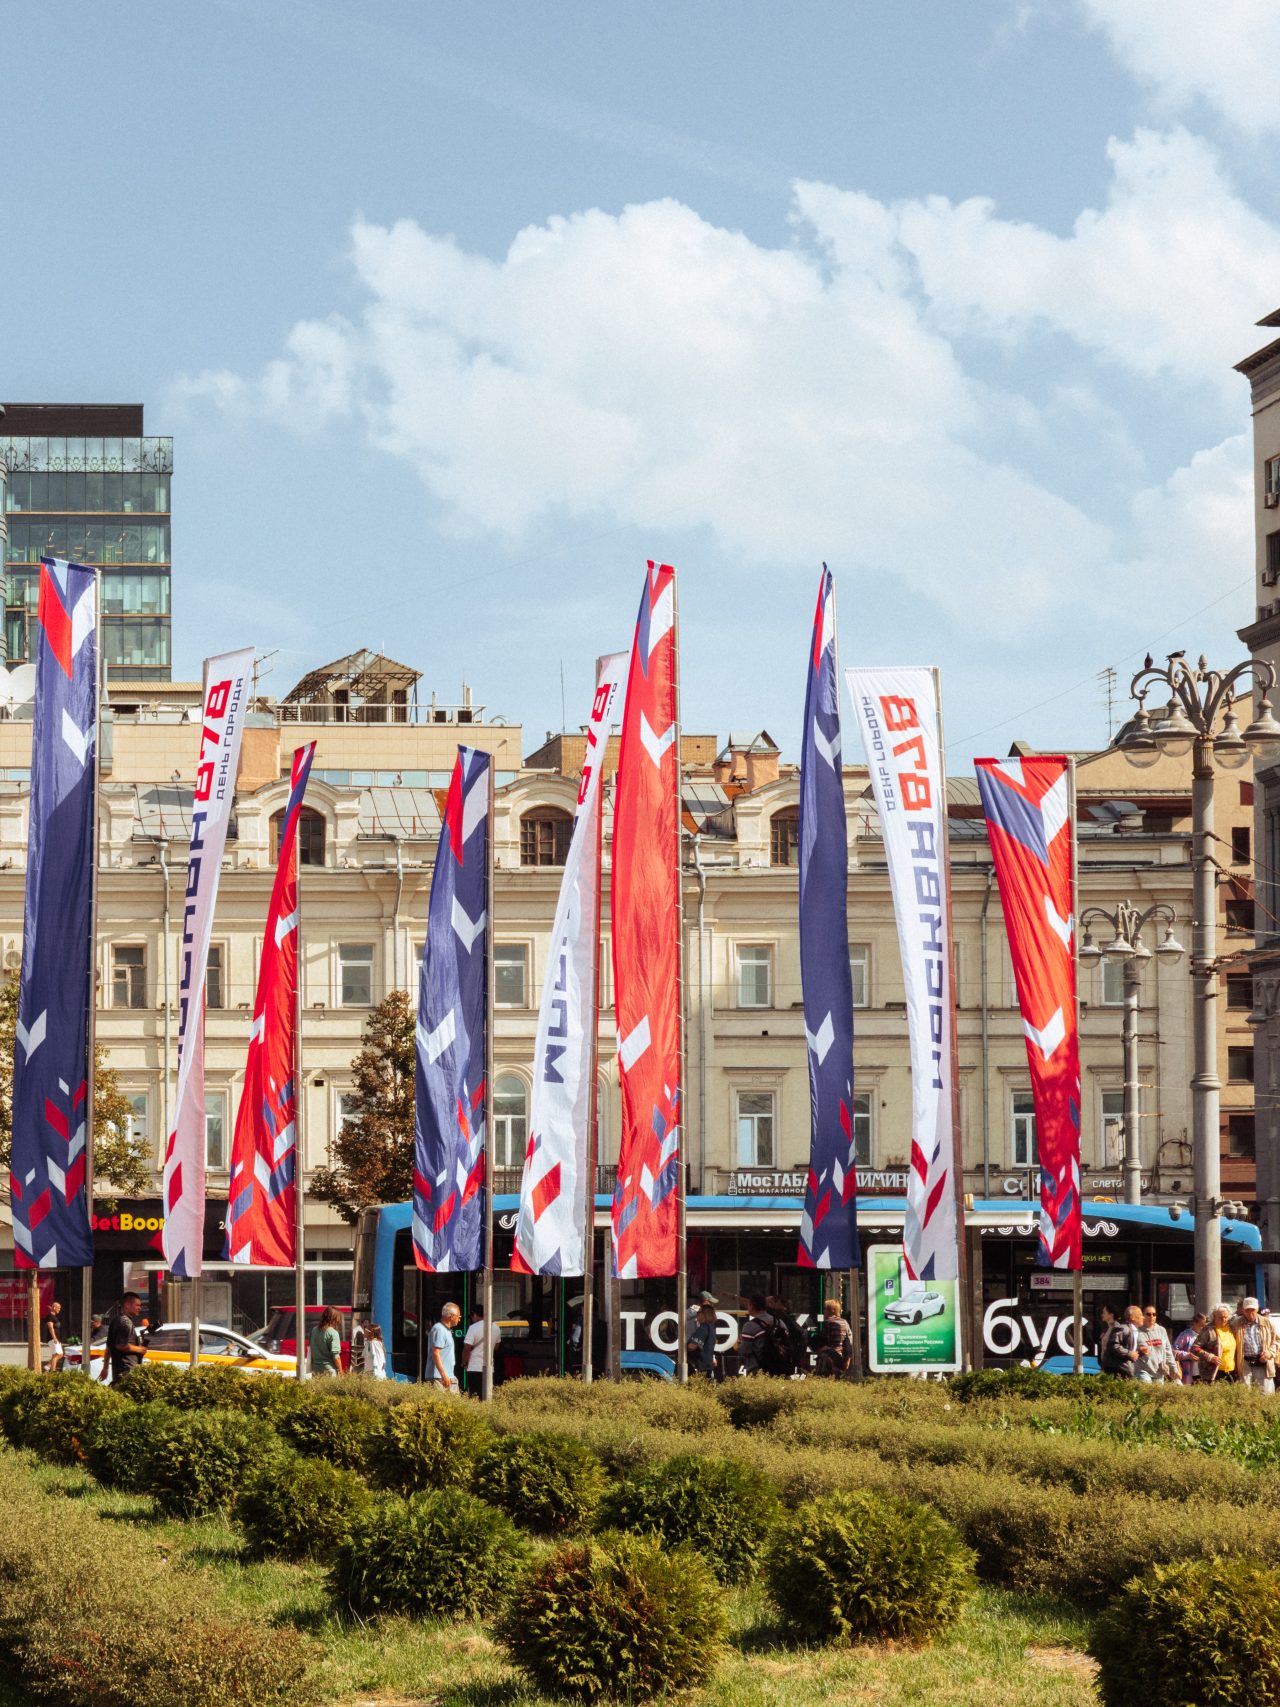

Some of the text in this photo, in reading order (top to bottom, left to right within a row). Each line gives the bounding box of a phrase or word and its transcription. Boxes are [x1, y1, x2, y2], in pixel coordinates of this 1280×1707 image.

[216, 677, 244, 800] ДЕНЬ ГОРОДА
[1034, 1277, 1050, 1285] 384
